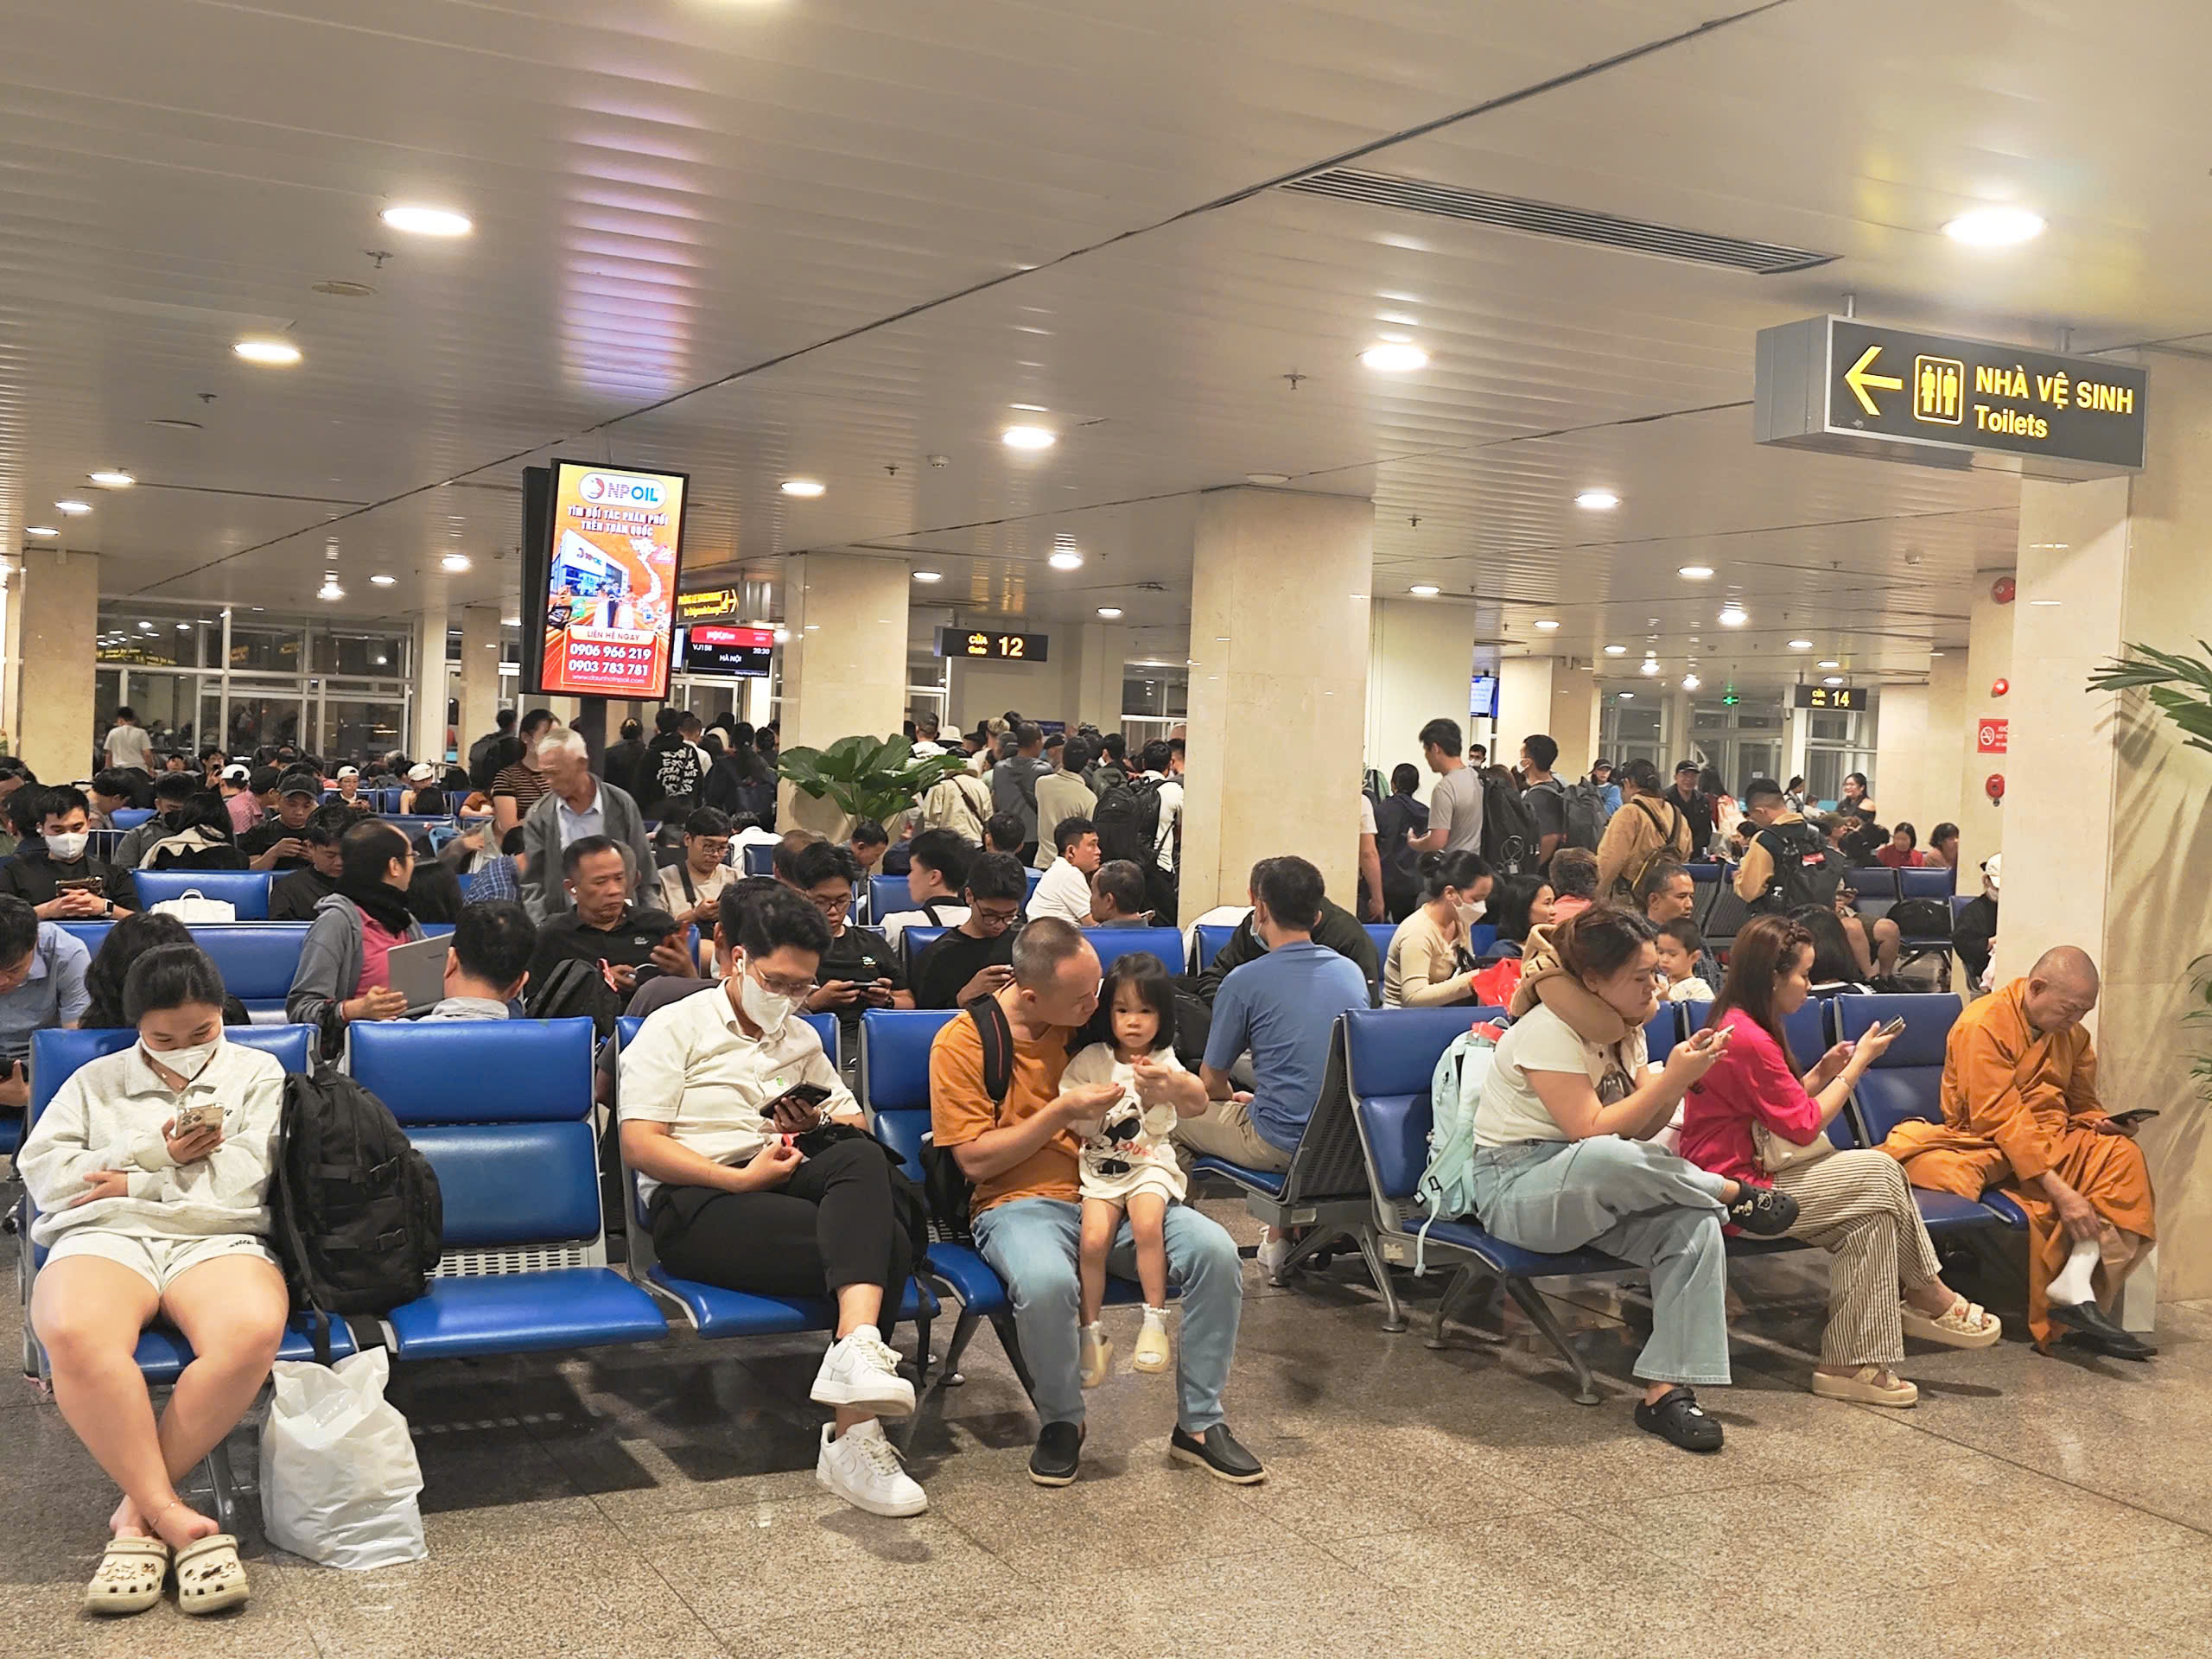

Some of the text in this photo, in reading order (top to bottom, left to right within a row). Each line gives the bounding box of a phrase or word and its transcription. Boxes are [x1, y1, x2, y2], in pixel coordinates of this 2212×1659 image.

[1974, 365, 2134, 415] NHÀ VỆ SINH
[1974, 404, 2049, 439] Toilets
[569, 643, 652, 660] 0906 966 219
[999, 636, 1024, 657] 12
[569, 659, 649, 677] 0903 783 781
[1832, 690, 1850, 707] 14
